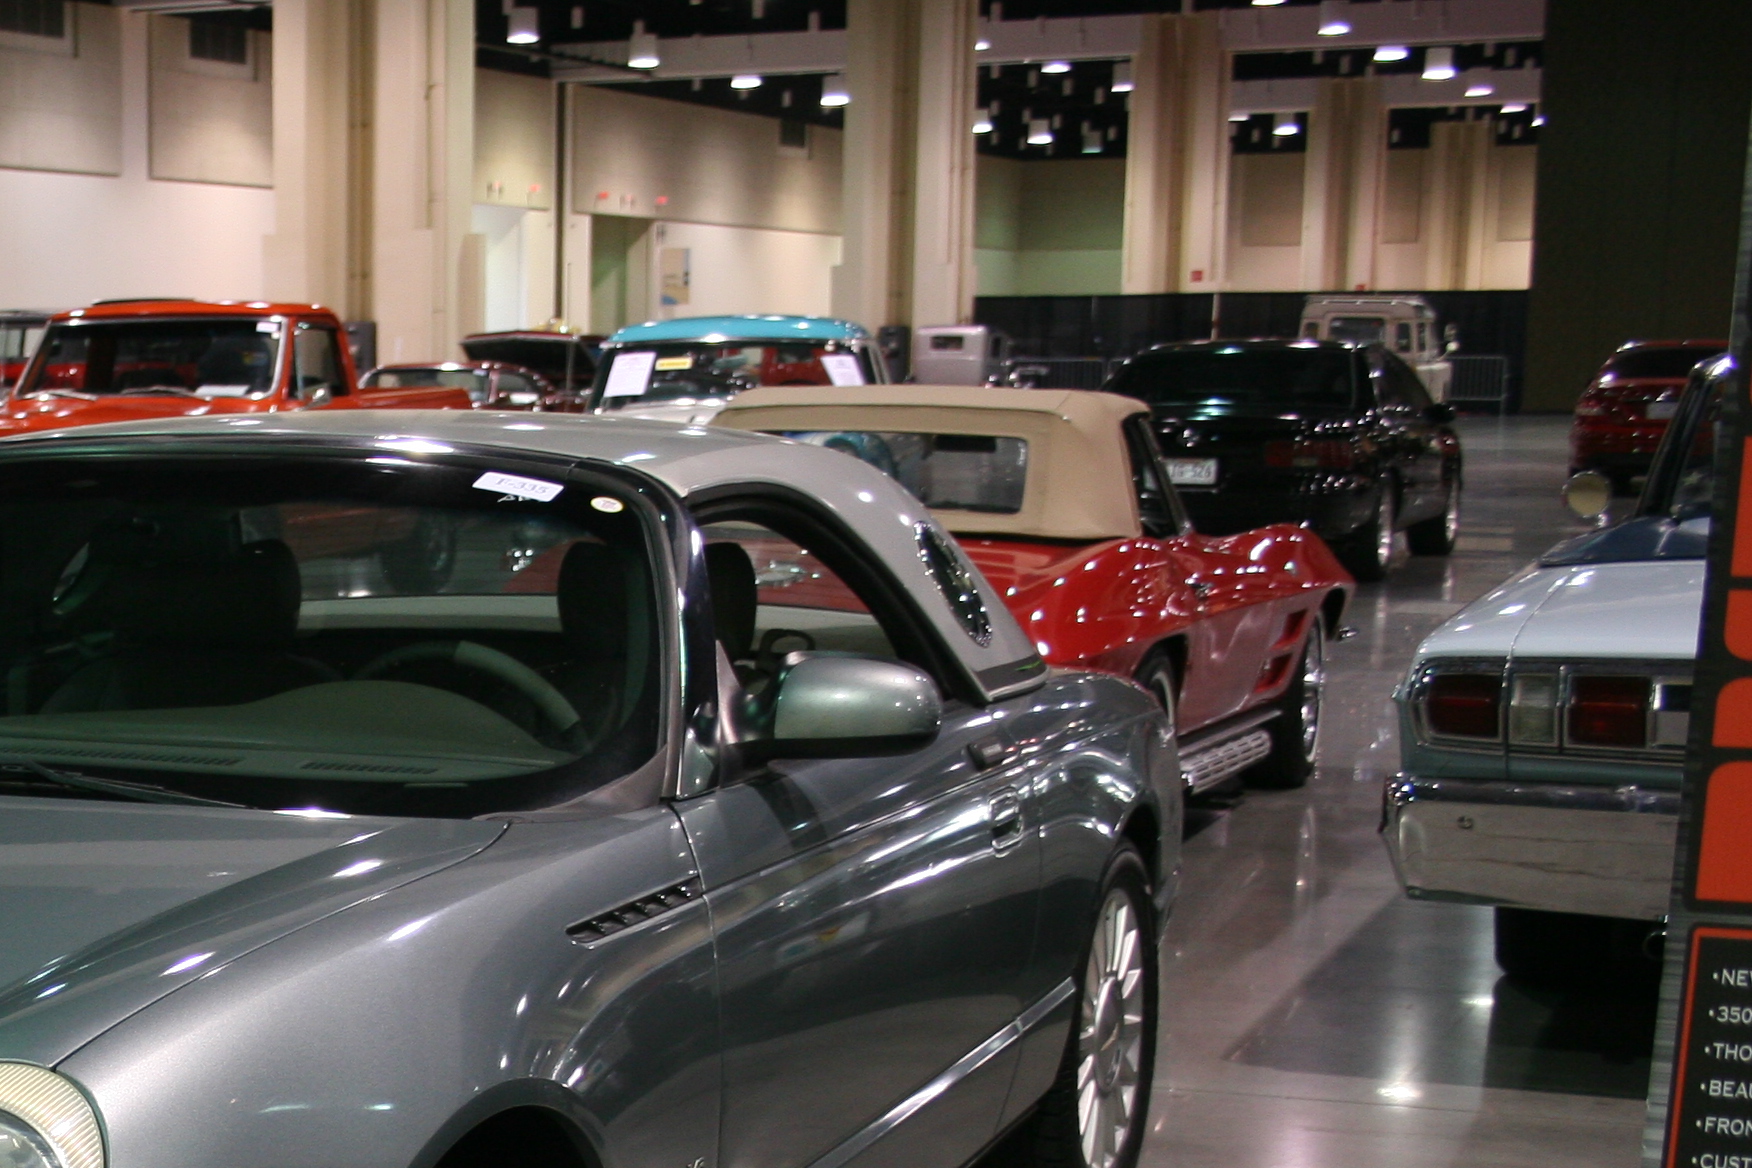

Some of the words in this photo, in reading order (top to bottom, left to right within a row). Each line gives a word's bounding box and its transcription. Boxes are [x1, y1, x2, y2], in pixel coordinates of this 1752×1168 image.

[1722, 968, 1752, 986] NE
[1716, 1006, 1752, 1024] 350
[1713, 1042, 1752, 1061] THO
